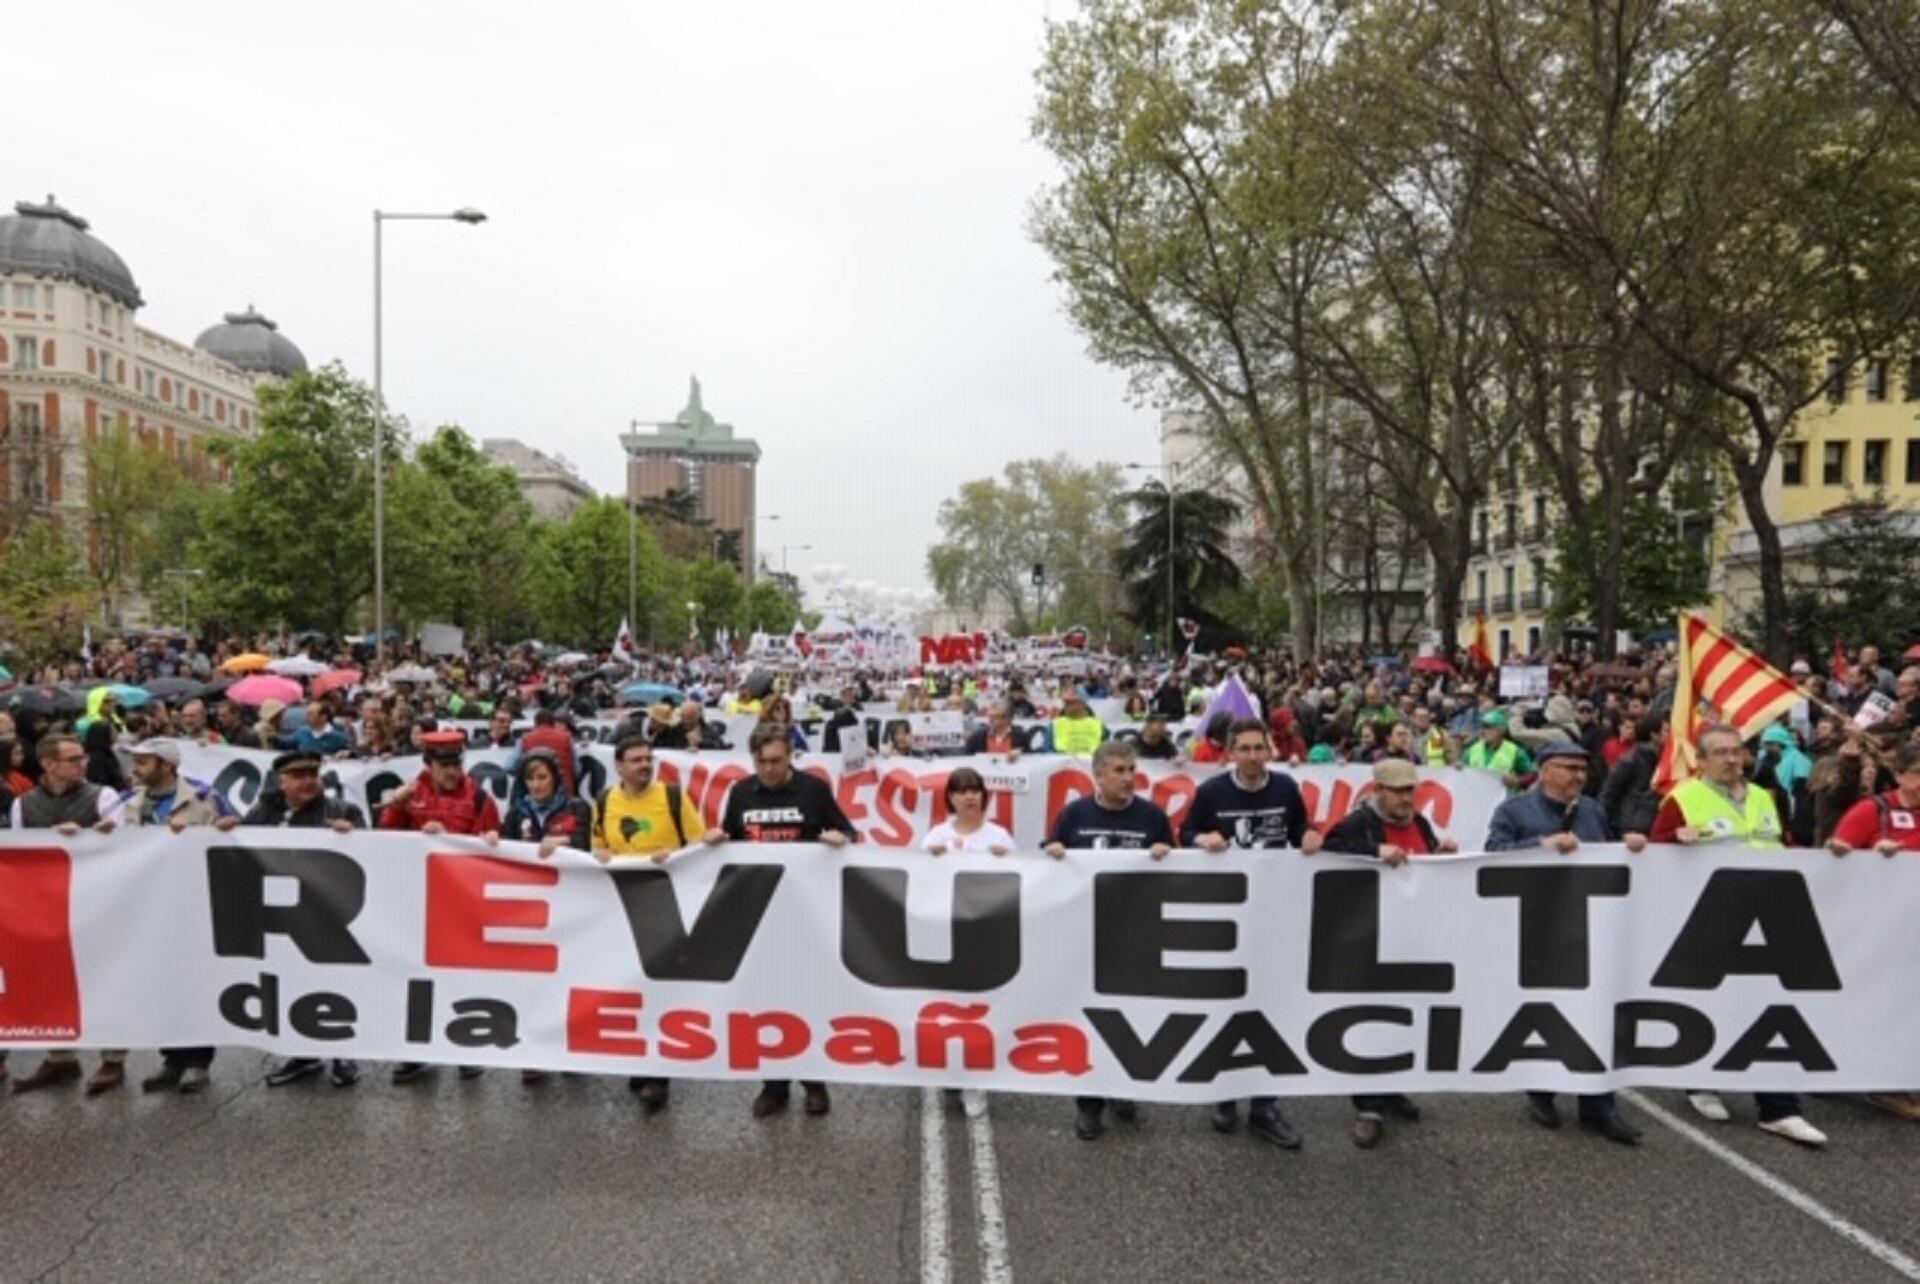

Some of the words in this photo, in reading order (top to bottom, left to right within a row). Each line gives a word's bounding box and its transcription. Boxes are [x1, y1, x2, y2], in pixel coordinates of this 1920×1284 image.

[207, 846, 1842, 1000] REVUELTA
[219, 972, 357, 1040] de
[407, 980, 520, 1049] la
